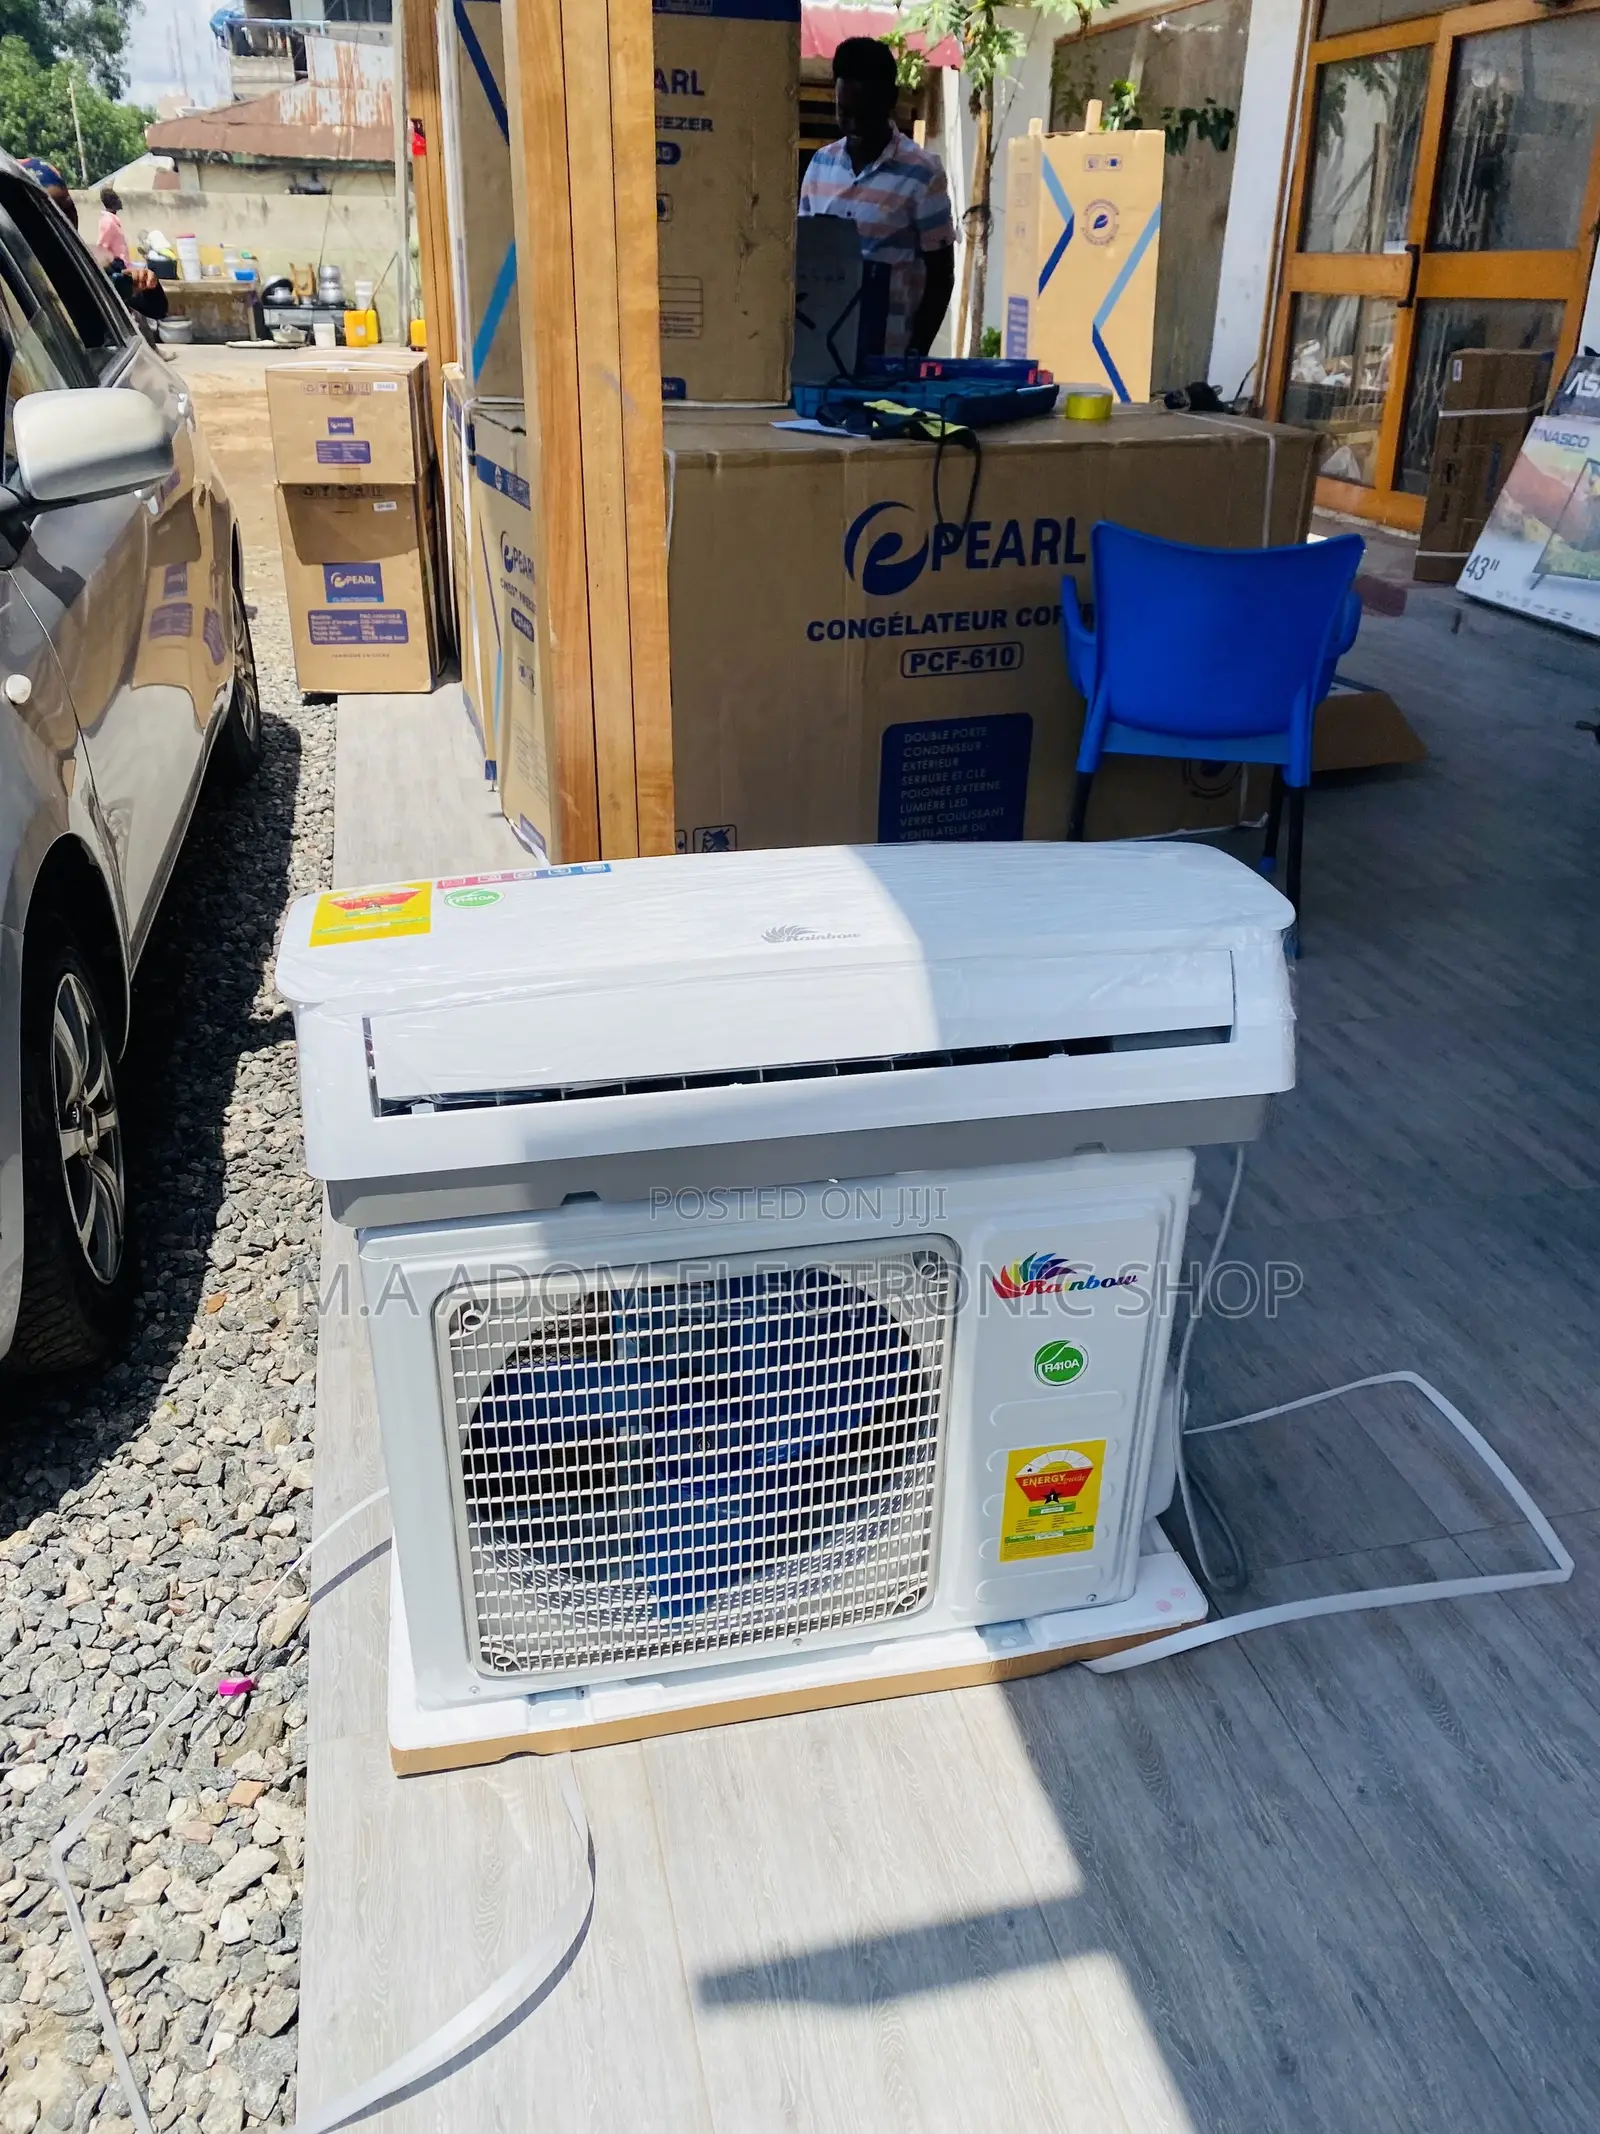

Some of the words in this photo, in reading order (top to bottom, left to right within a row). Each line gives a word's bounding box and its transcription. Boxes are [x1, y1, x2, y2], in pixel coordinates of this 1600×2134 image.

[654, 67, 705, 96] ARL
[1541, 429, 1590, 449] NASCO
[931, 516, 1087, 572] PEARL
[1465, 553, 1500, 582] 43"
[345, 574, 377, 585] PEARL
[806, 608, 1008, 642] CONGÉLATEUR
[909, 646, 1015, 674] PCF-610
[904, 730, 949, 744] DOUBLE
[952, 727, 989, 739] PORTE
[903, 741, 982, 758] CONDENSEUR
[902, 772, 949, 786] SERRURE
[955, 780, 1001, 794] EXTERNE
[949, 797, 968, 809] LED
[900, 814, 934, 827] VERRE
[936, 807, 1005, 823] COULISSANT
[900, 825, 969, 841] VENTILATEUR
[1021, 1264, 1139, 1296] Rainbow
[1044, 1357, 1080, 1373] R410A
[1022, 1473, 1067, 1488] ENERGY
[1049, 1493, 1055, 1501] 1
